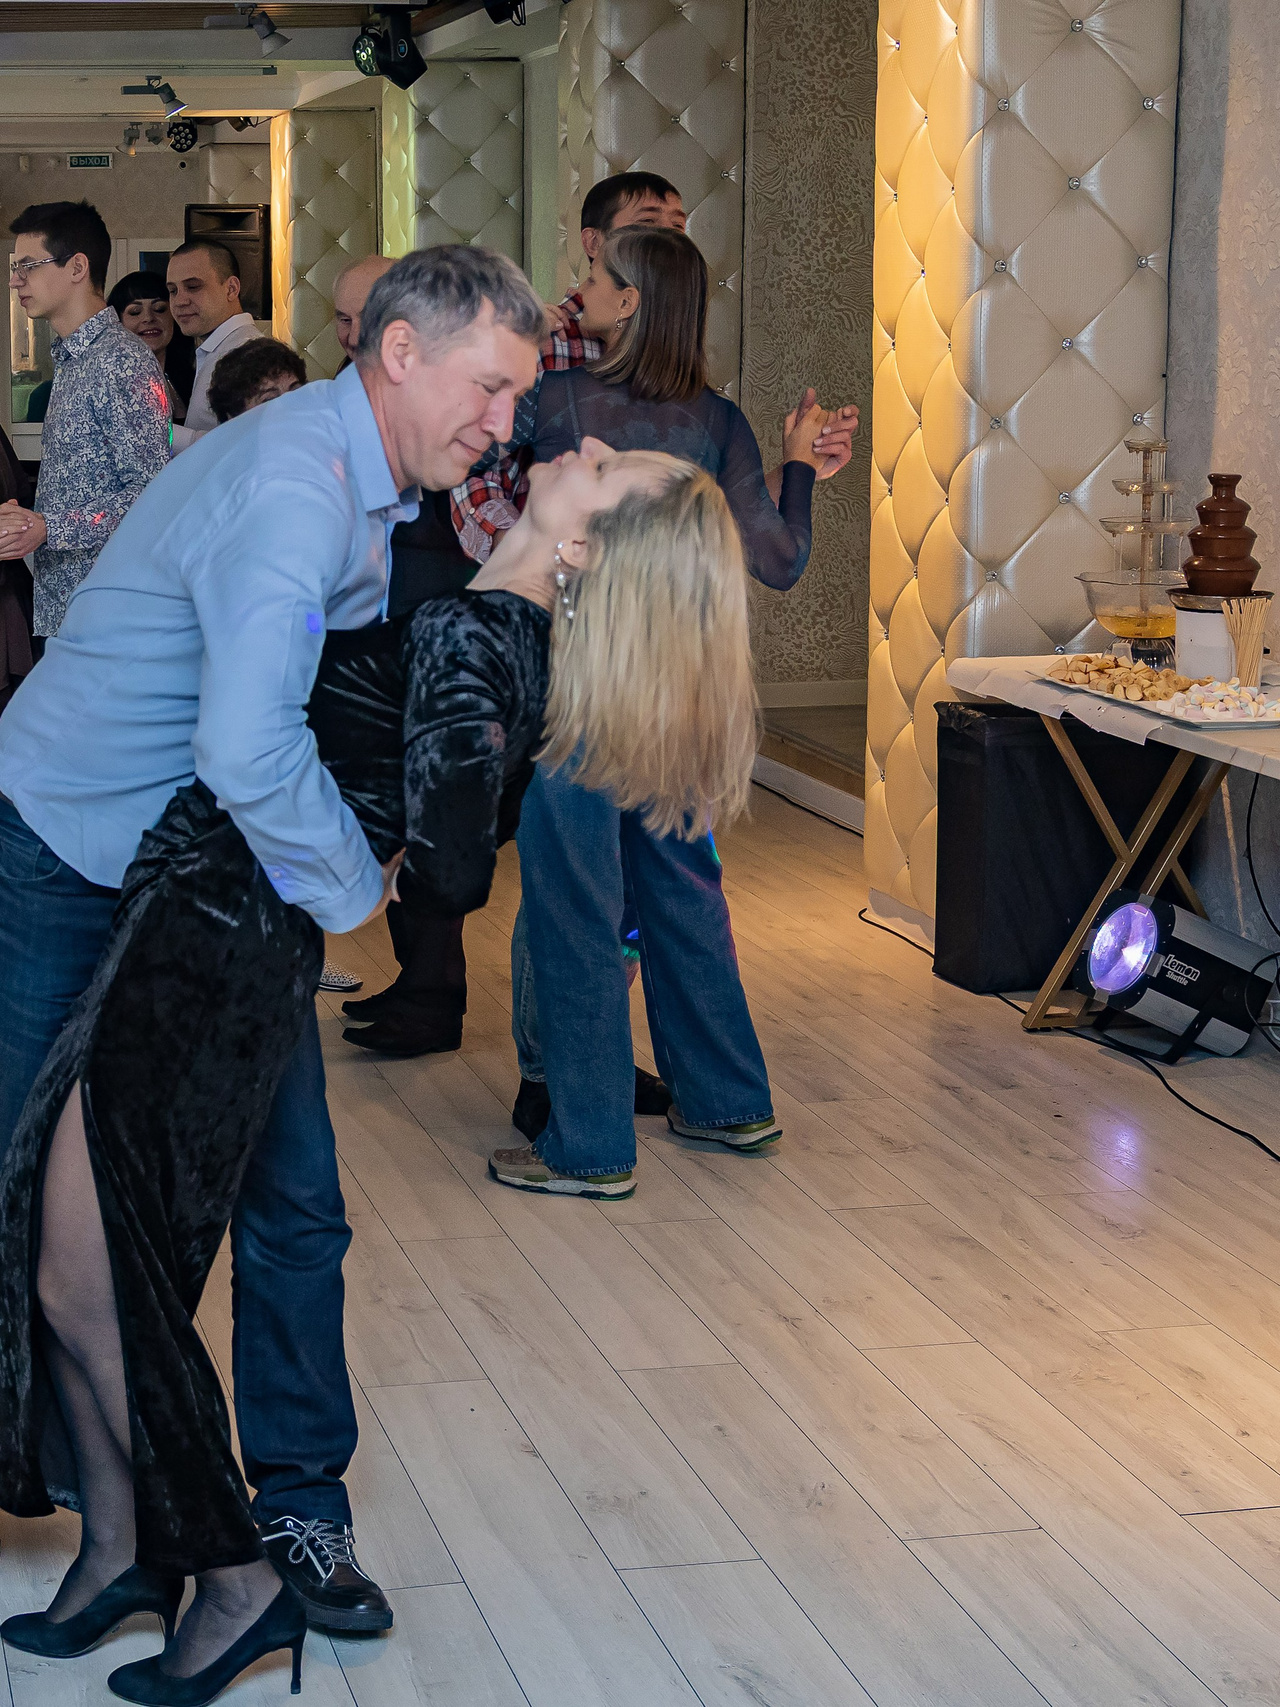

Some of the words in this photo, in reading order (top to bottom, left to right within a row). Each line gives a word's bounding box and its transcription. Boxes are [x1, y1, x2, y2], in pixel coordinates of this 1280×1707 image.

[71, 156, 108, 166] ВЫХОД
[1163, 954, 1200, 981] Lemon
[1165, 970, 1189, 986] Shuttle
